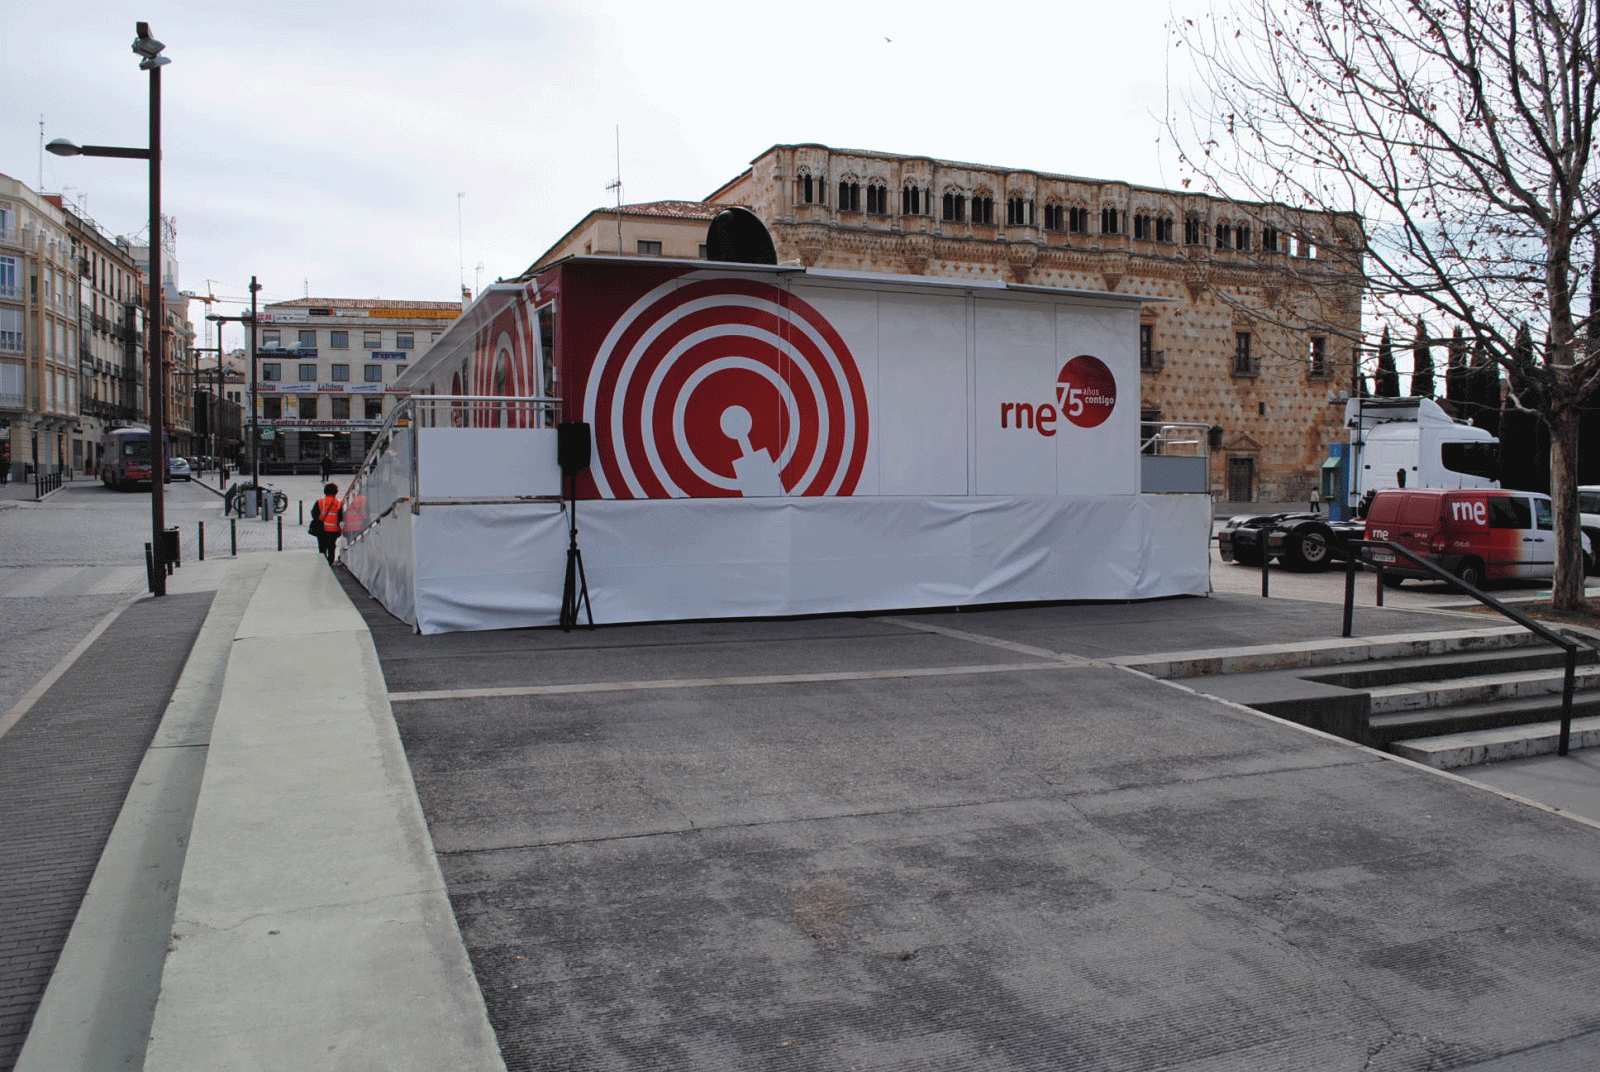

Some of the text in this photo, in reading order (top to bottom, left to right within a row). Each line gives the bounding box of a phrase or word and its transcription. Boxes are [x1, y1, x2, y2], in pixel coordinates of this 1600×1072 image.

[1082, 387, 1099, 396] años
[1084, 395, 1114, 406] contigo
[1001, 402, 1057, 437] rne
[1451, 500, 1486, 525] rne
[1372, 528, 1389, 541] rne
